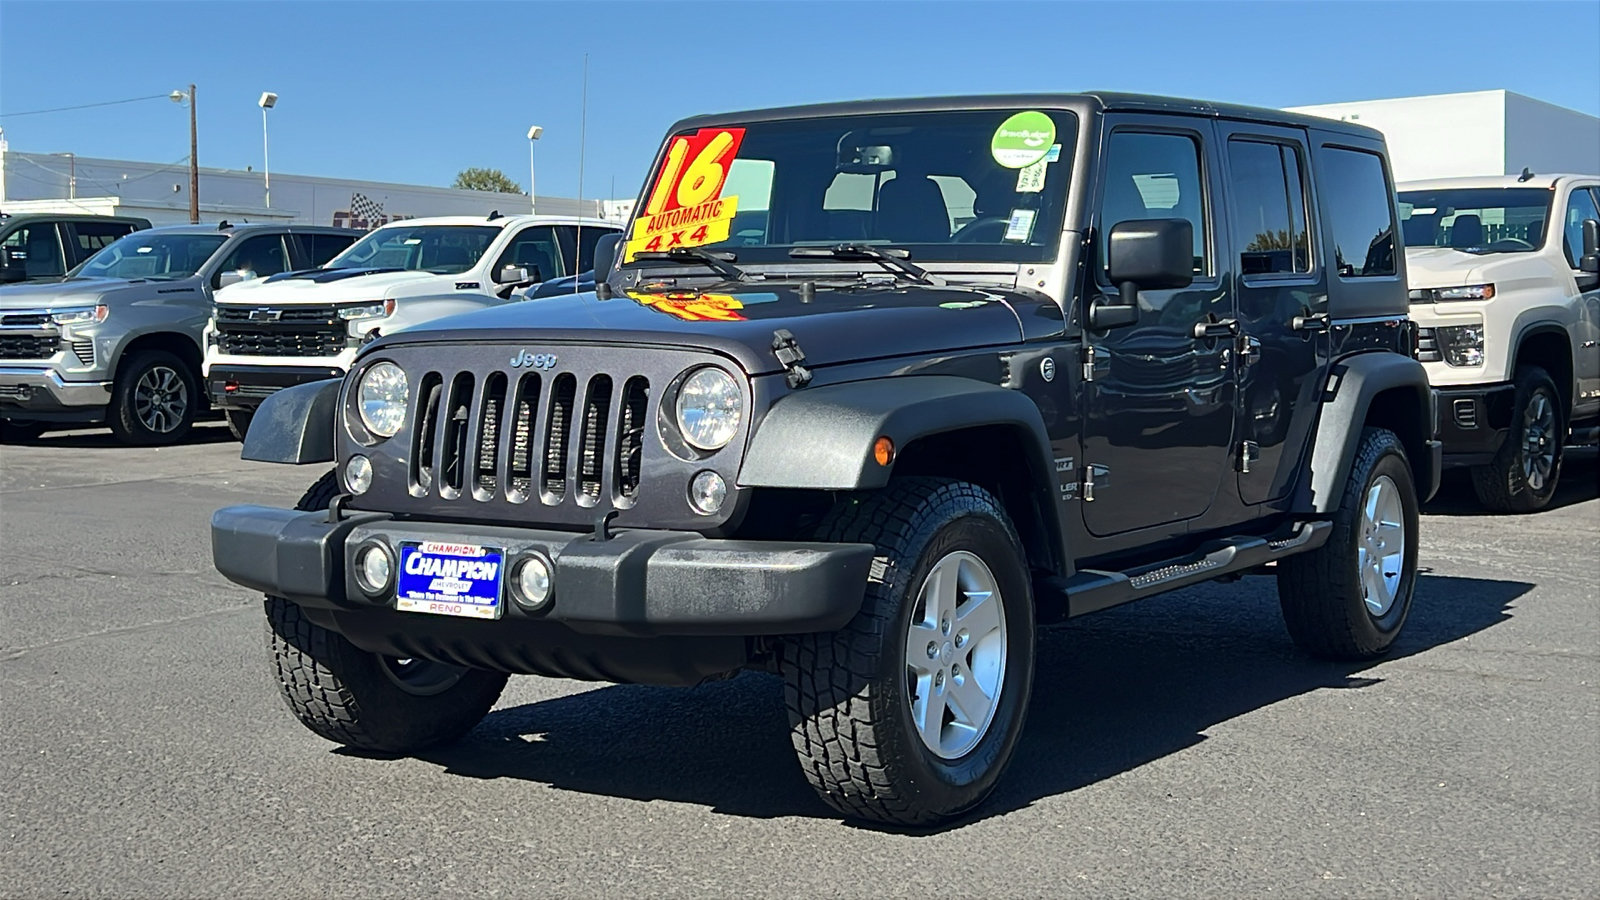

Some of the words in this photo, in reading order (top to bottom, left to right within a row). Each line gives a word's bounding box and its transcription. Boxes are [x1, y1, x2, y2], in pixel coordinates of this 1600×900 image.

[647, 131, 734, 215] 16
[646, 200, 723, 234] AUTOMATIC
[510, 347, 557, 371] Jeep
[427, 543, 476, 555] CHAMPION
[405, 551, 498, 581] CHAMPION
[433, 581, 469, 591] CHEVROLET
[429, 603, 462, 614] RENO
